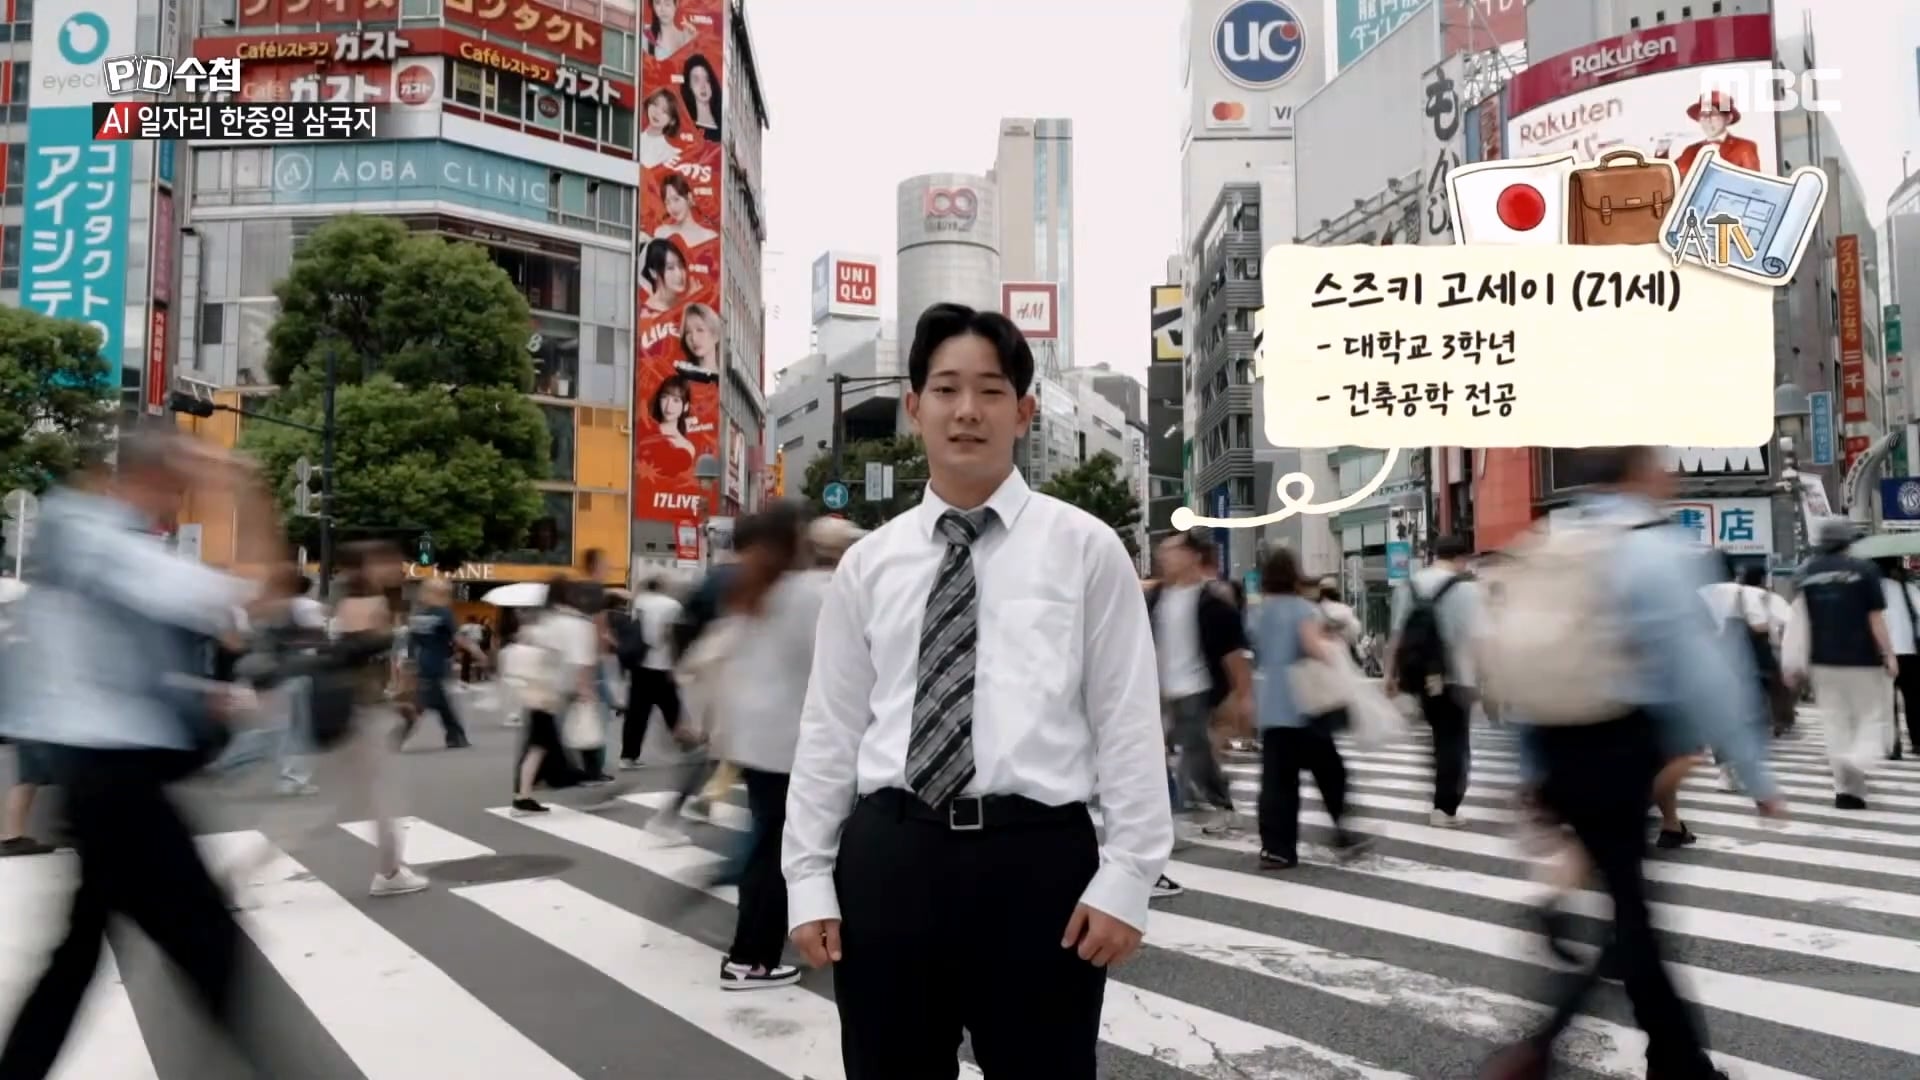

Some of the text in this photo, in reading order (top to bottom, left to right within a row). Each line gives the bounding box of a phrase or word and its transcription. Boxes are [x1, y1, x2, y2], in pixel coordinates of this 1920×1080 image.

[334, 30, 409, 61] ガスト
[1571, 36, 1677, 77] Rakuten
[554, 66, 621, 104] ガスト
[1520, 98, 1623, 145] Rakuten
[333, 160, 546, 202] AOBA CLINIC
[924, 187, 977, 231] 109
[840, 267, 870, 282] UNI
[840, 284, 872, 300] QLO
